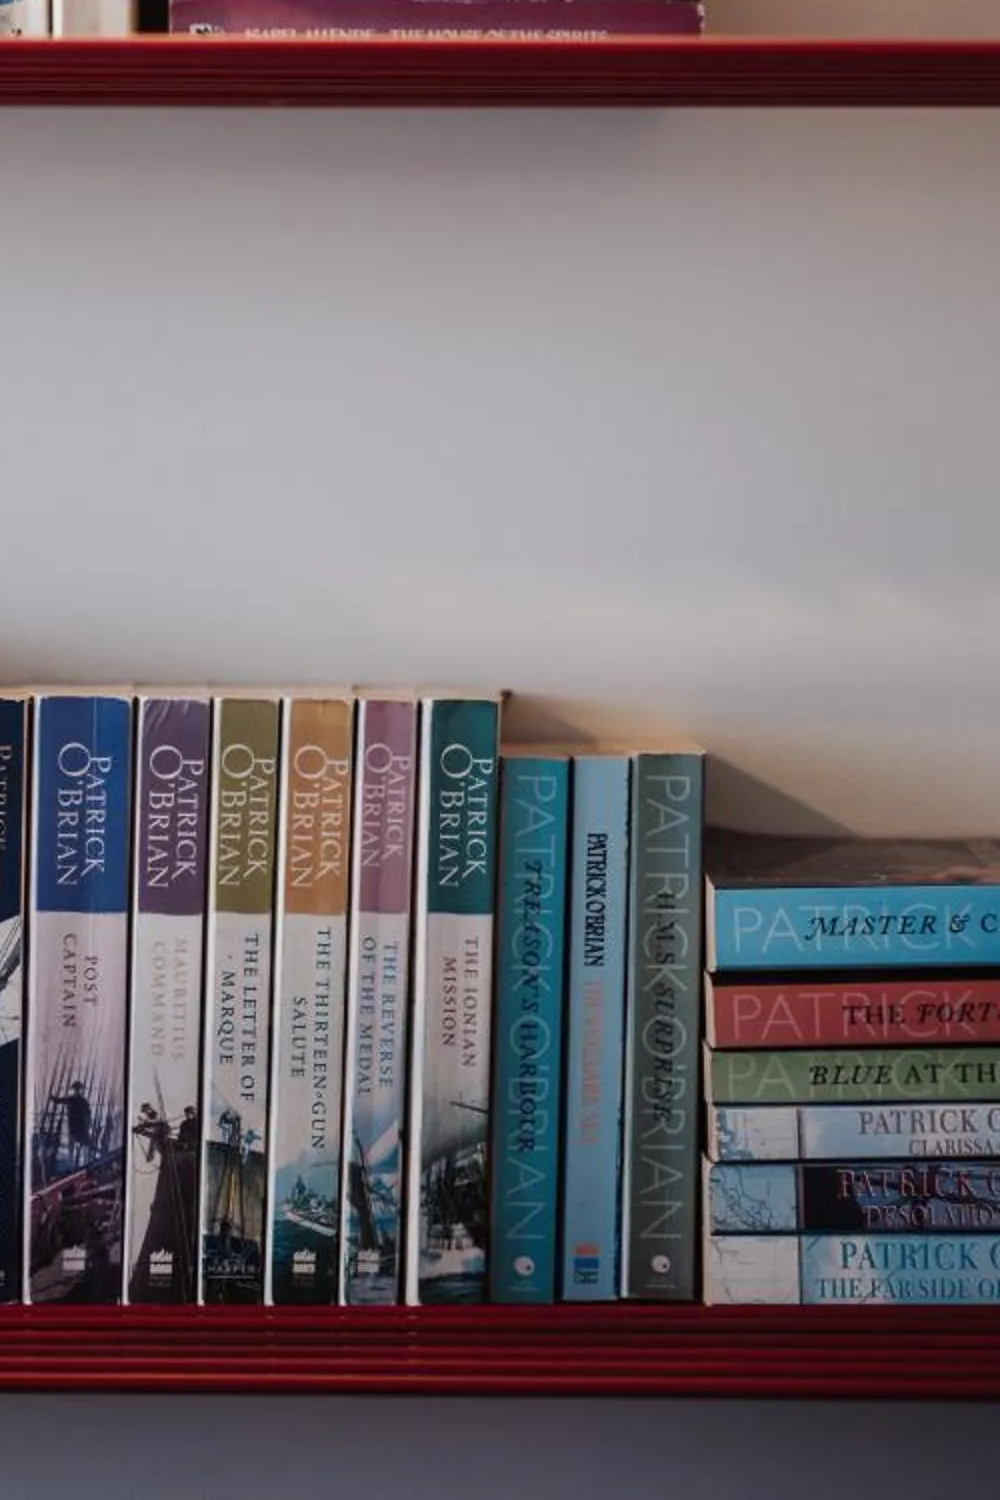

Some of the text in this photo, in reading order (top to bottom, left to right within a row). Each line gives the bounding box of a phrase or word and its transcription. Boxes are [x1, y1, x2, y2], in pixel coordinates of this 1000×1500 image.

[57, 742, 92, 885] O'BRIAN
[80, 756, 112, 878] PATRICK
[147, 745, 185, 888] O'BRIAN
[171, 759, 205, 880] PATRICK
[218, 743, 255, 886] O'BRIAN
[243, 758, 276, 879] PATRICK
[290, 744, 330, 888] O'BRIAN
[315, 758, 348, 880] PATRICK
[362, 742, 395, 867] O'BRIAN
[381, 755, 412, 860] PATRICK
[438, 743, 474, 888] O'BRIAN
[461, 757, 493, 879] PATRICK
[584, 832, 609, 900] PATRICK
[62, 932, 78, 1030] CAPTAIN
[83, 955, 99, 1006] POST
[316, 927, 332, 970] THE
[732, 901, 978, 954] PATRICK
[804, 913, 971, 941] MASTER &
[151, 940, 167, 1058] COMMAND
[172, 936, 189, 1062] MAURITIUS
[217, 969, 237, 1065] MARQUE
[240, 932, 260, 1102] THE LETTER OF
[291, 996, 308, 1080] SALUTE
[358, 936, 378, 1098] OF THE MEDAL
[378, 941, 398, 1089] THE REVERSE
[441, 956, 459, 1048] MISSION
[461, 935, 480, 1069] THE IONIAN
[505, 775, 557, 1240] PATRICK O'BRIAN
[639, 775, 691, 1240] PATRICK O'BRIAN
[651, 981, 677, 1125] SURPRISE
[732, 989, 978, 1041] PATRICK
[841, 1004, 907, 1025] THE
[518, 1021, 541, 1153] HARBOUR
[809, 1063, 945, 1086] BLUE AT
[858, 1108, 979, 1135] PATRICK
[836, 1166, 977, 1198] PATRICK
[907, 1138, 994, 1156] CLARISSA
[839, 1240, 978, 1270] PATRICK
[863, 1203, 1000, 1228] DESOLATIO
[815, 1276, 972, 1299] THE FAR SIDE
